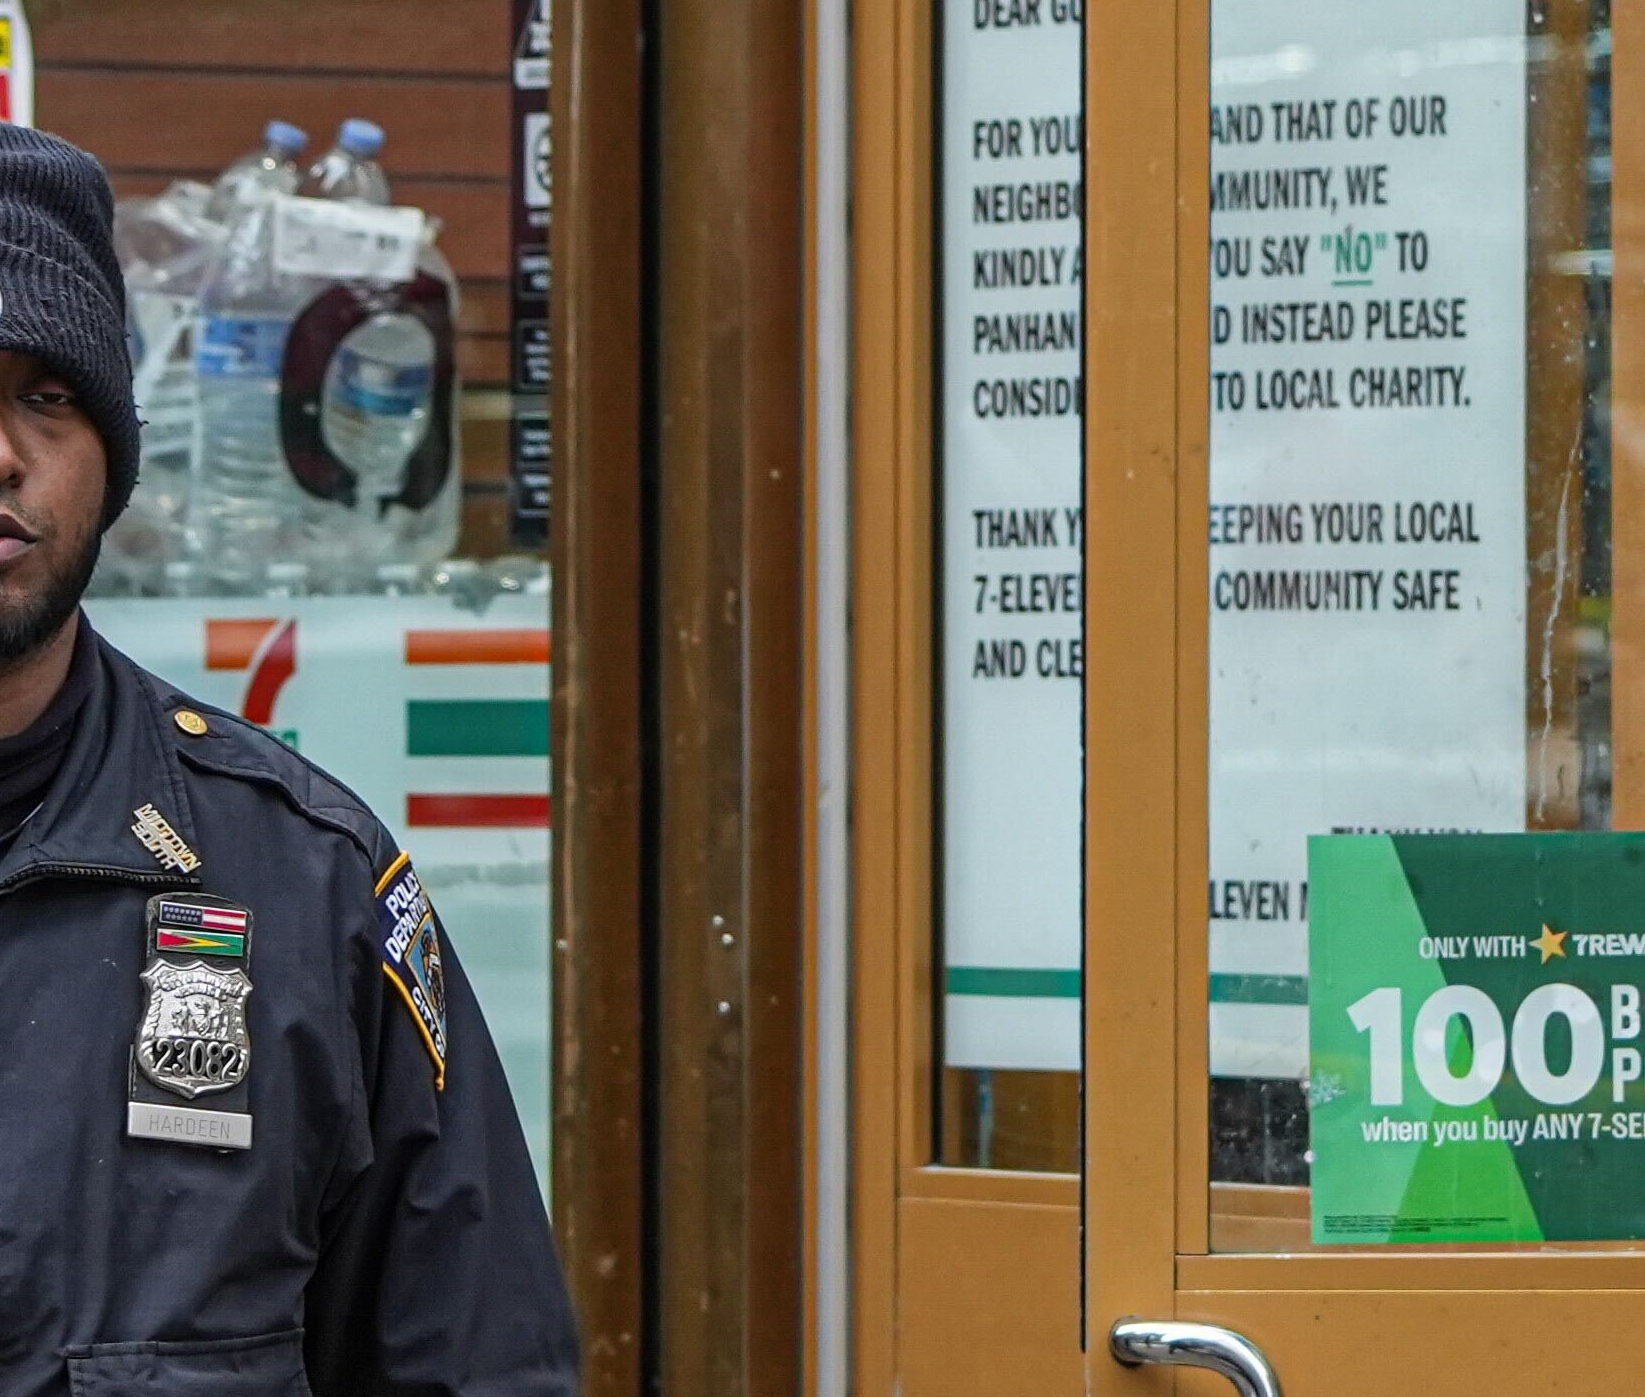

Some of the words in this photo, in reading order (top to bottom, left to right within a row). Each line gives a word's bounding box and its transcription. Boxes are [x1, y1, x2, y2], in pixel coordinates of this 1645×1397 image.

[973, 117, 1023, 159] FOR
[1029, 114, 1081, 156] YOU
[1210, 104, 1263, 145] AND
[1272, 101, 1336, 143] THAT
[1345, 98, 1379, 139] OF
[1389, 95, 1448, 137] OUR
[1210, 168, 1340, 216] MMUNITY,
[1345, 165, 1389, 206] WE
[974, 244, 1066, 289] KINDLY
[1211, 239, 1251, 277] OU
[1261, 236, 1310, 276] SAY
[1396, 231, 1430, 272] TO
[973, 310, 1076, 355] PANHAN
[1242, 302, 1355, 343] INSTEAD
[1366, 297, 1469, 340] PLEASE
[1211, 372, 1245, 410] TO
[1256, 368, 1340, 410] LOCAL
[1350, 365, 1473, 409] CHARITY.
[973, 507, 1059, 549] THANK
[1208, 502, 1302, 544] EEPING
[1311, 501, 1383, 544] YOUR
[1394, 501, 1481, 543] LOCAL
[974, 573, 1081, 614] 7-ELEVE
[1214, 570, 1383, 612] COMMUNITY
[1393, 568, 1460, 610] SAFE
[973, 639, 1028, 679] AND
[1036, 638, 1082, 679] CLE
[130, 820, 177, 870] SOUTH
[133, 803, 203, 874] MIDTOWN
[1209, 879, 1290, 921] LEVEN
[1419, 936, 1469, 959] ONLY
[1472, 935, 1526, 958] WITH
[156, 1038, 240, 1083] 23082
[1345, 982, 1606, 1106] 100
[148, 1109, 231, 1140] HARDEEN
[1361, 1118, 1429, 1143] when
[1433, 1119, 1478, 1147] you
[1483, 1113, 1528, 1146] buy
[1531, 1114, 1584, 1140] ANY
